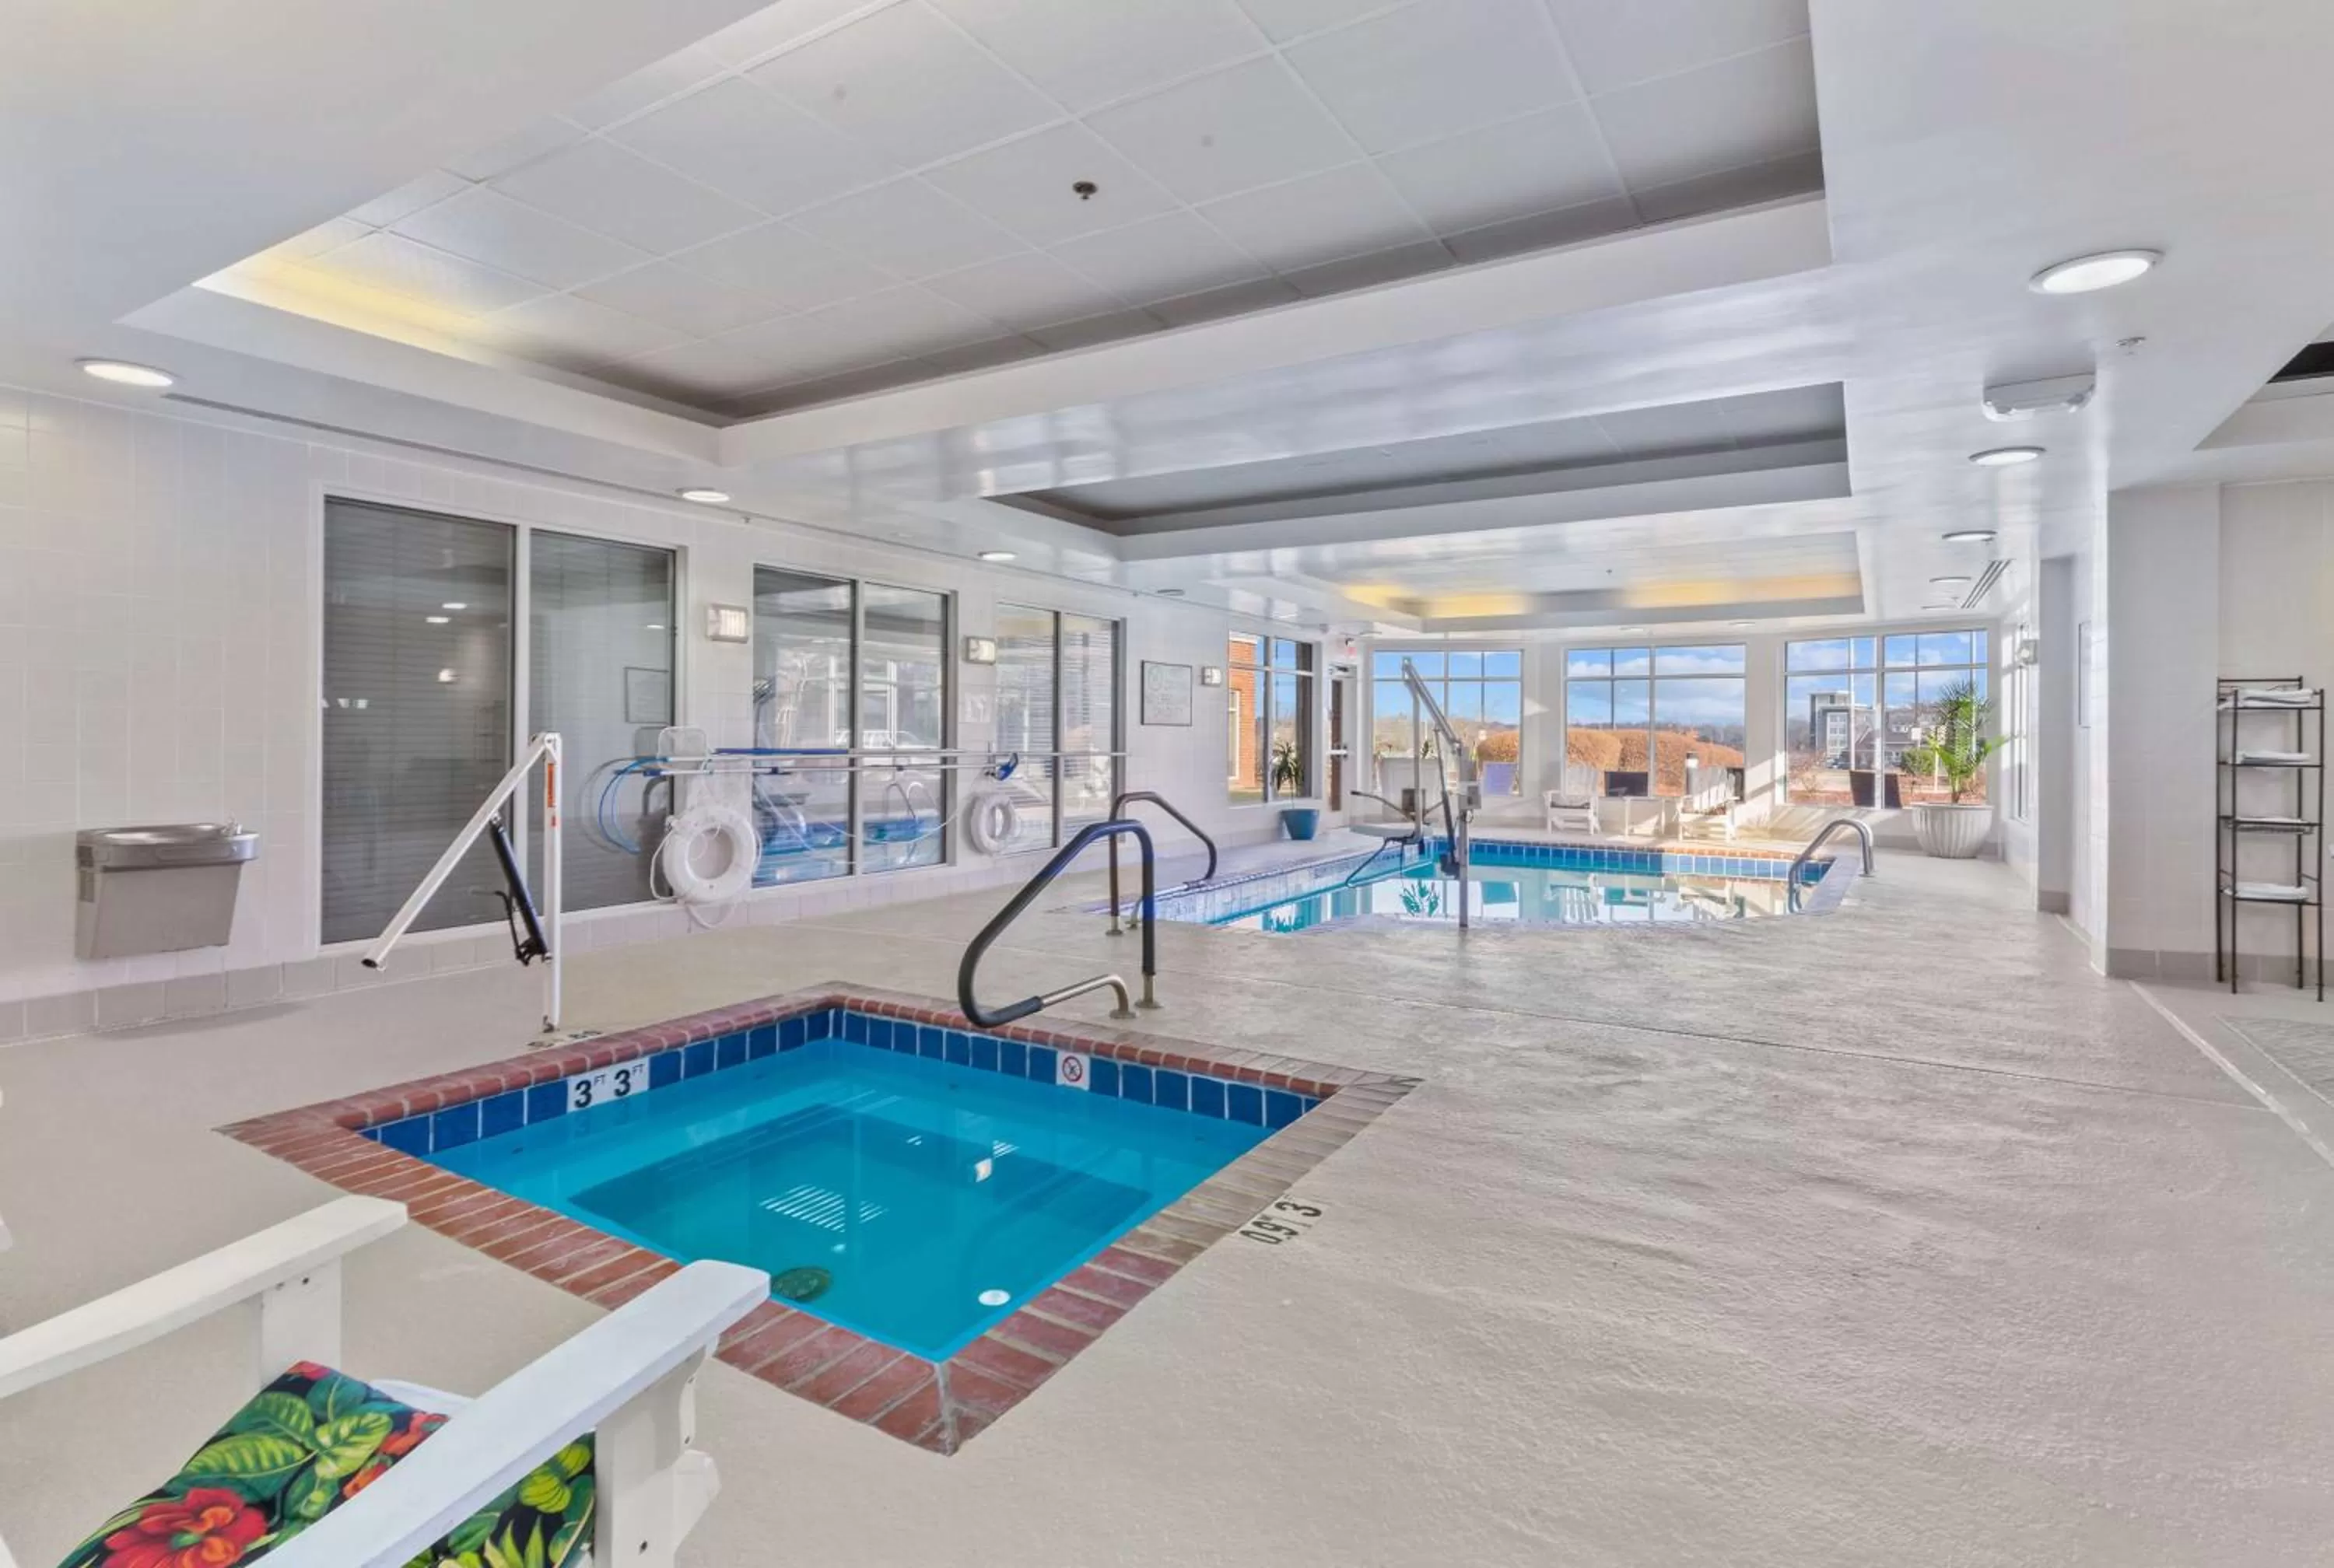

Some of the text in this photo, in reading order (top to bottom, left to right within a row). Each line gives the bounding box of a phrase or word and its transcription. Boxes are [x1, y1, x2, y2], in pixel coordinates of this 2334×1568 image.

[574, 1079, 592, 1108] 3
[614, 1069, 631, 1097] 3
[1275, 1202, 1321, 1217] 3
